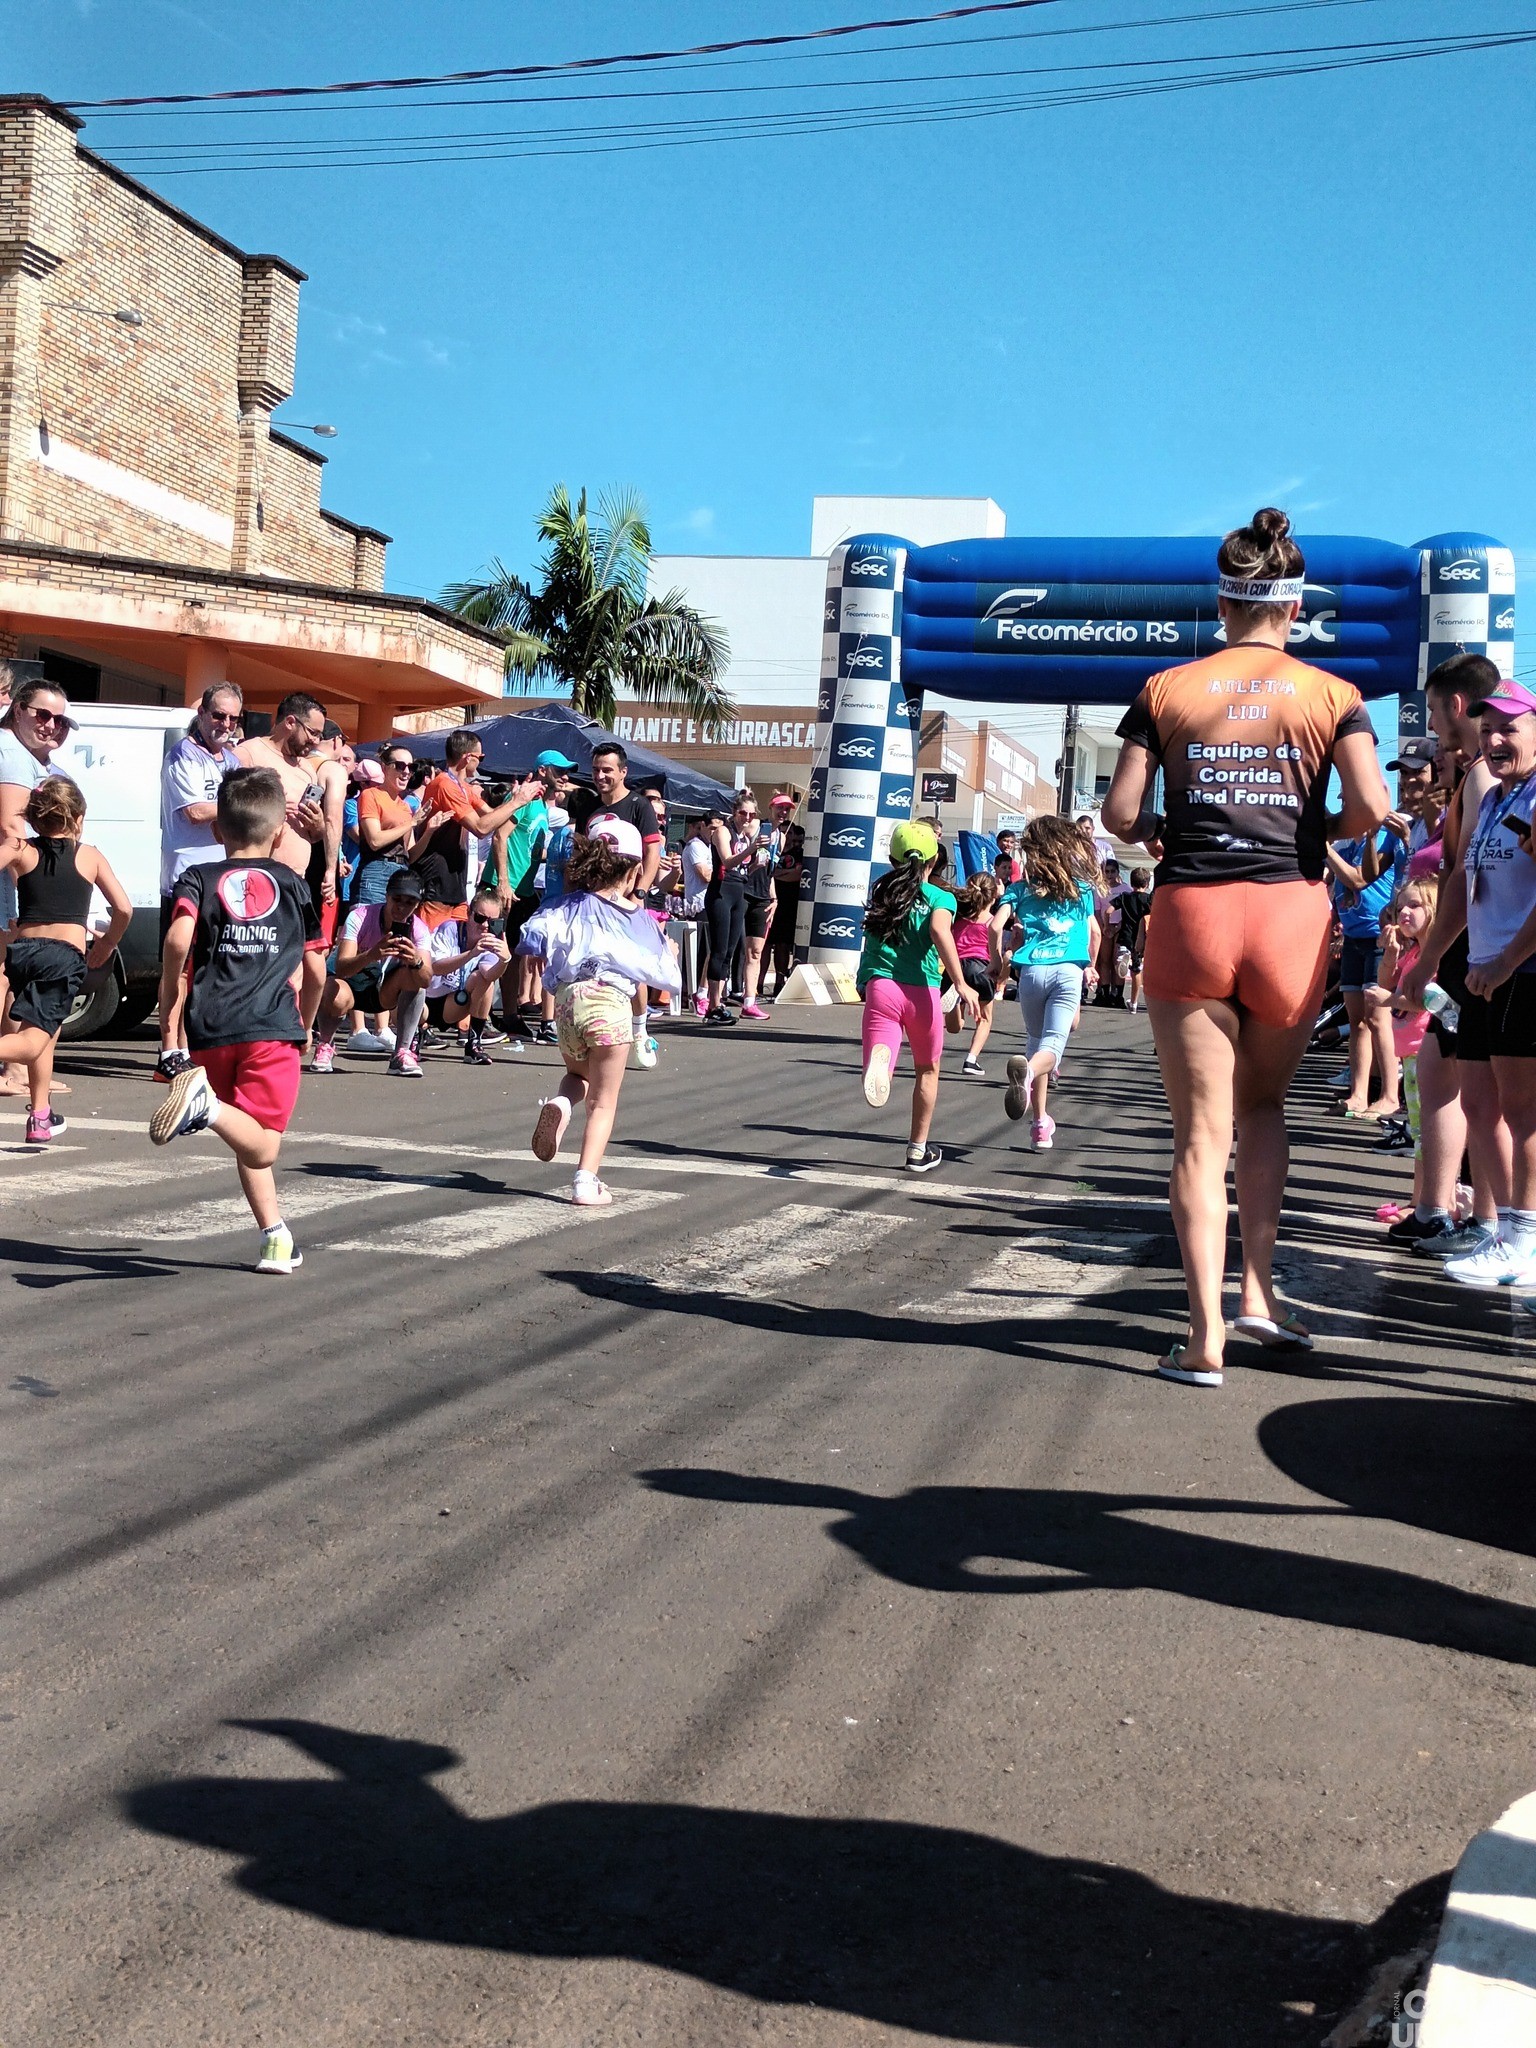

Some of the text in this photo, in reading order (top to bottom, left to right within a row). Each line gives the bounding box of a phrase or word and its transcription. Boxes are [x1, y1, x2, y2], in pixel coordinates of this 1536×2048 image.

[1249, 583, 1272, 596] COM
[846, 610, 880, 618] Fecomércio
[997, 619, 1180, 643] Fecomércio RS
[1209, 678, 1297, 695] ATLETA
[1227, 705, 1268, 720] LIDI
[686, 718, 697, 744] E
[1187, 742, 1302, 762] Equipe de
[1199, 767, 1282, 784] Corrida
[831, 791, 865, 800] Fecomércio
[1234, 789, 1299, 807] Forma
[821, 881, 855, 890] Fecomércio
[222, 924, 277, 941] RUNNING
